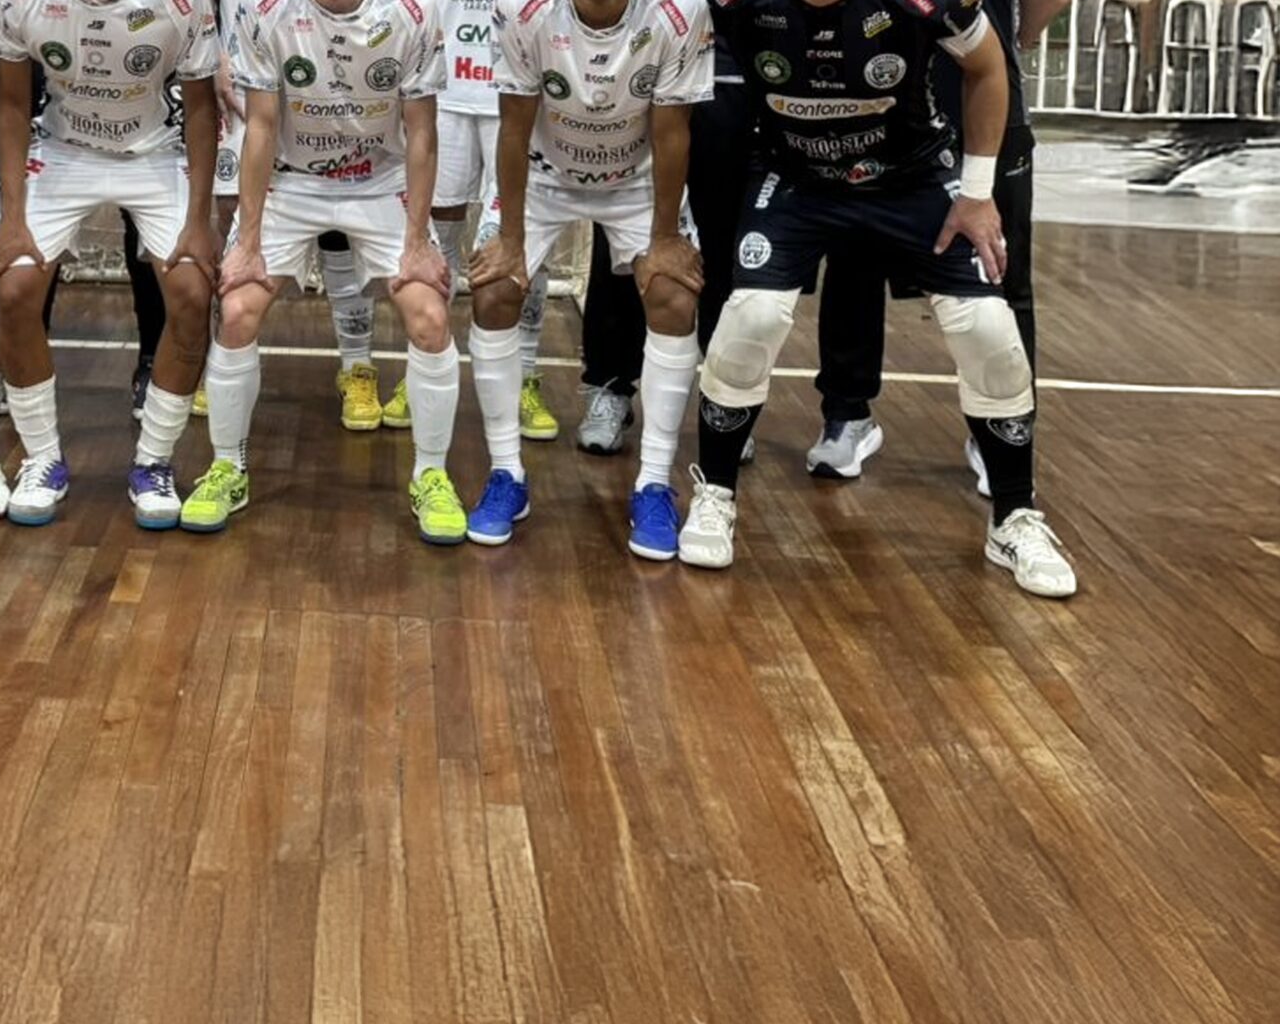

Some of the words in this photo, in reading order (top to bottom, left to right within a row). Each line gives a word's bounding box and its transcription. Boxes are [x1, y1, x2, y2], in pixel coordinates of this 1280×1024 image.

[456, 23, 491, 43] GM
[786, 99, 860, 117] contorno
[560, 116, 628, 133] contorno
